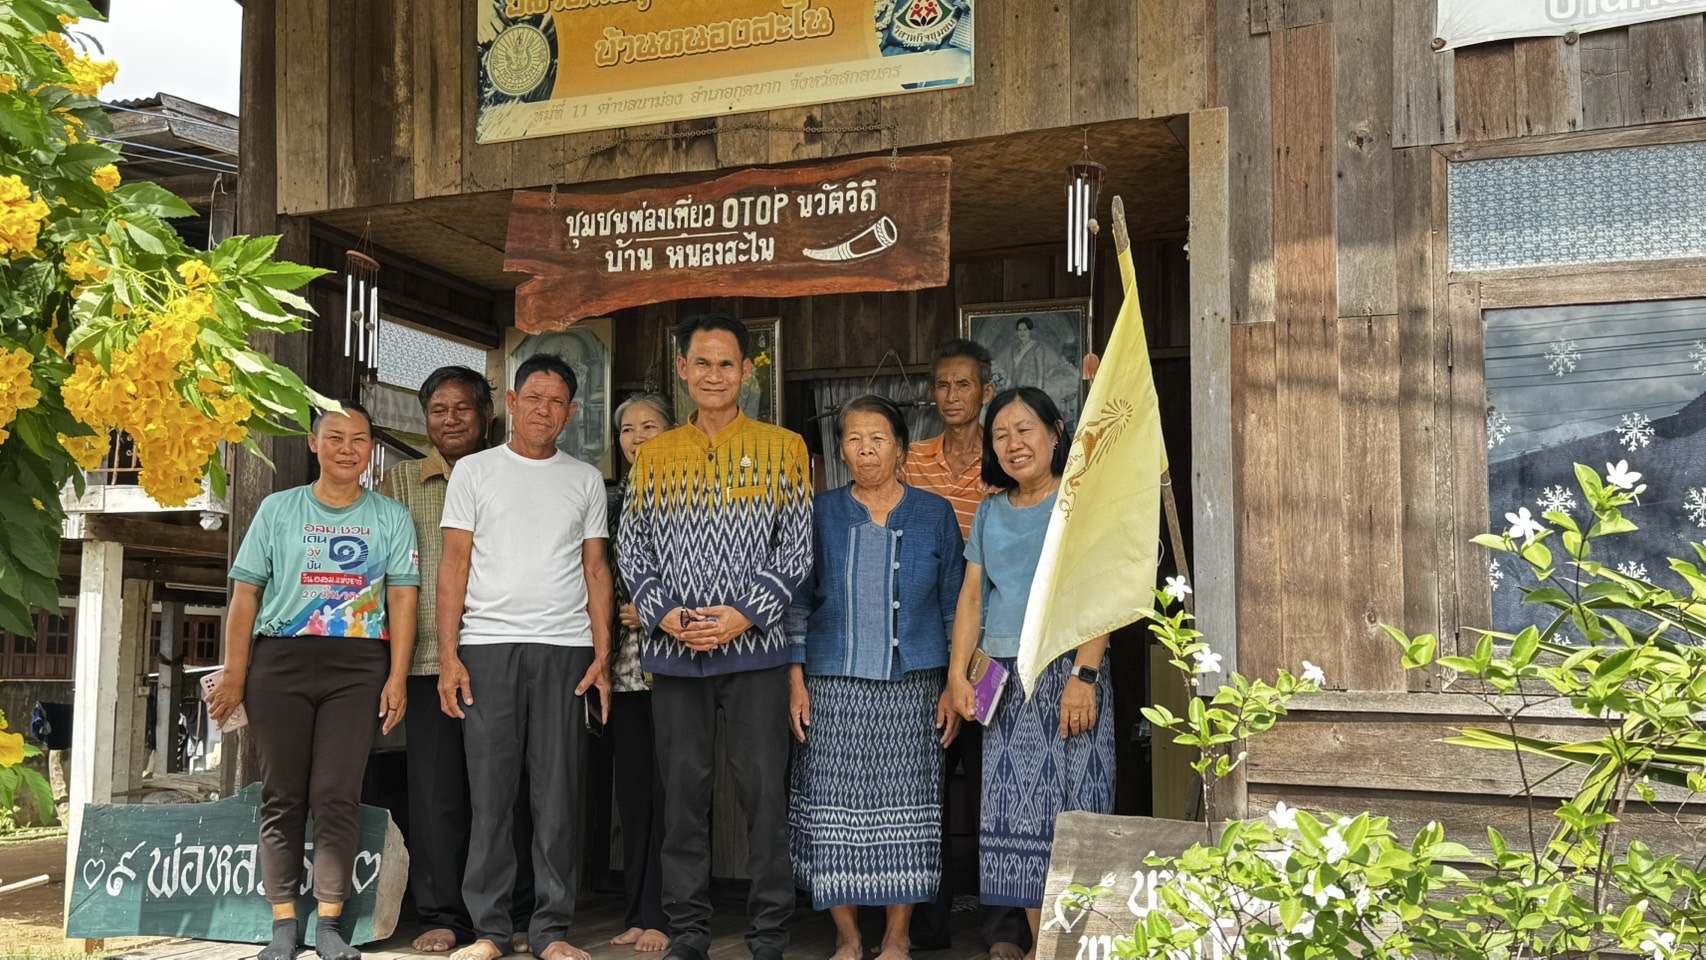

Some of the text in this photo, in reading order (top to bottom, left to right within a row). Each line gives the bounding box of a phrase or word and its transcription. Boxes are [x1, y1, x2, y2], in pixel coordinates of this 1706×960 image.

[595, 0, 835, 67] บ้านหนองสะไน
[532, 64, 903, 126] หมู่ที่ 11 ตำบลนาม่อง อำเภอกุดบาก จังหวัดสกลนคร
[565, 179, 877, 249] ชุมชนท่องเที่ยว OTOP นวัตวิถี
[605, 232, 775, 273] บ้าน หนองสะไน
[303, 533, 327, 544] เดิน
[301, 590, 317, 599] 20
